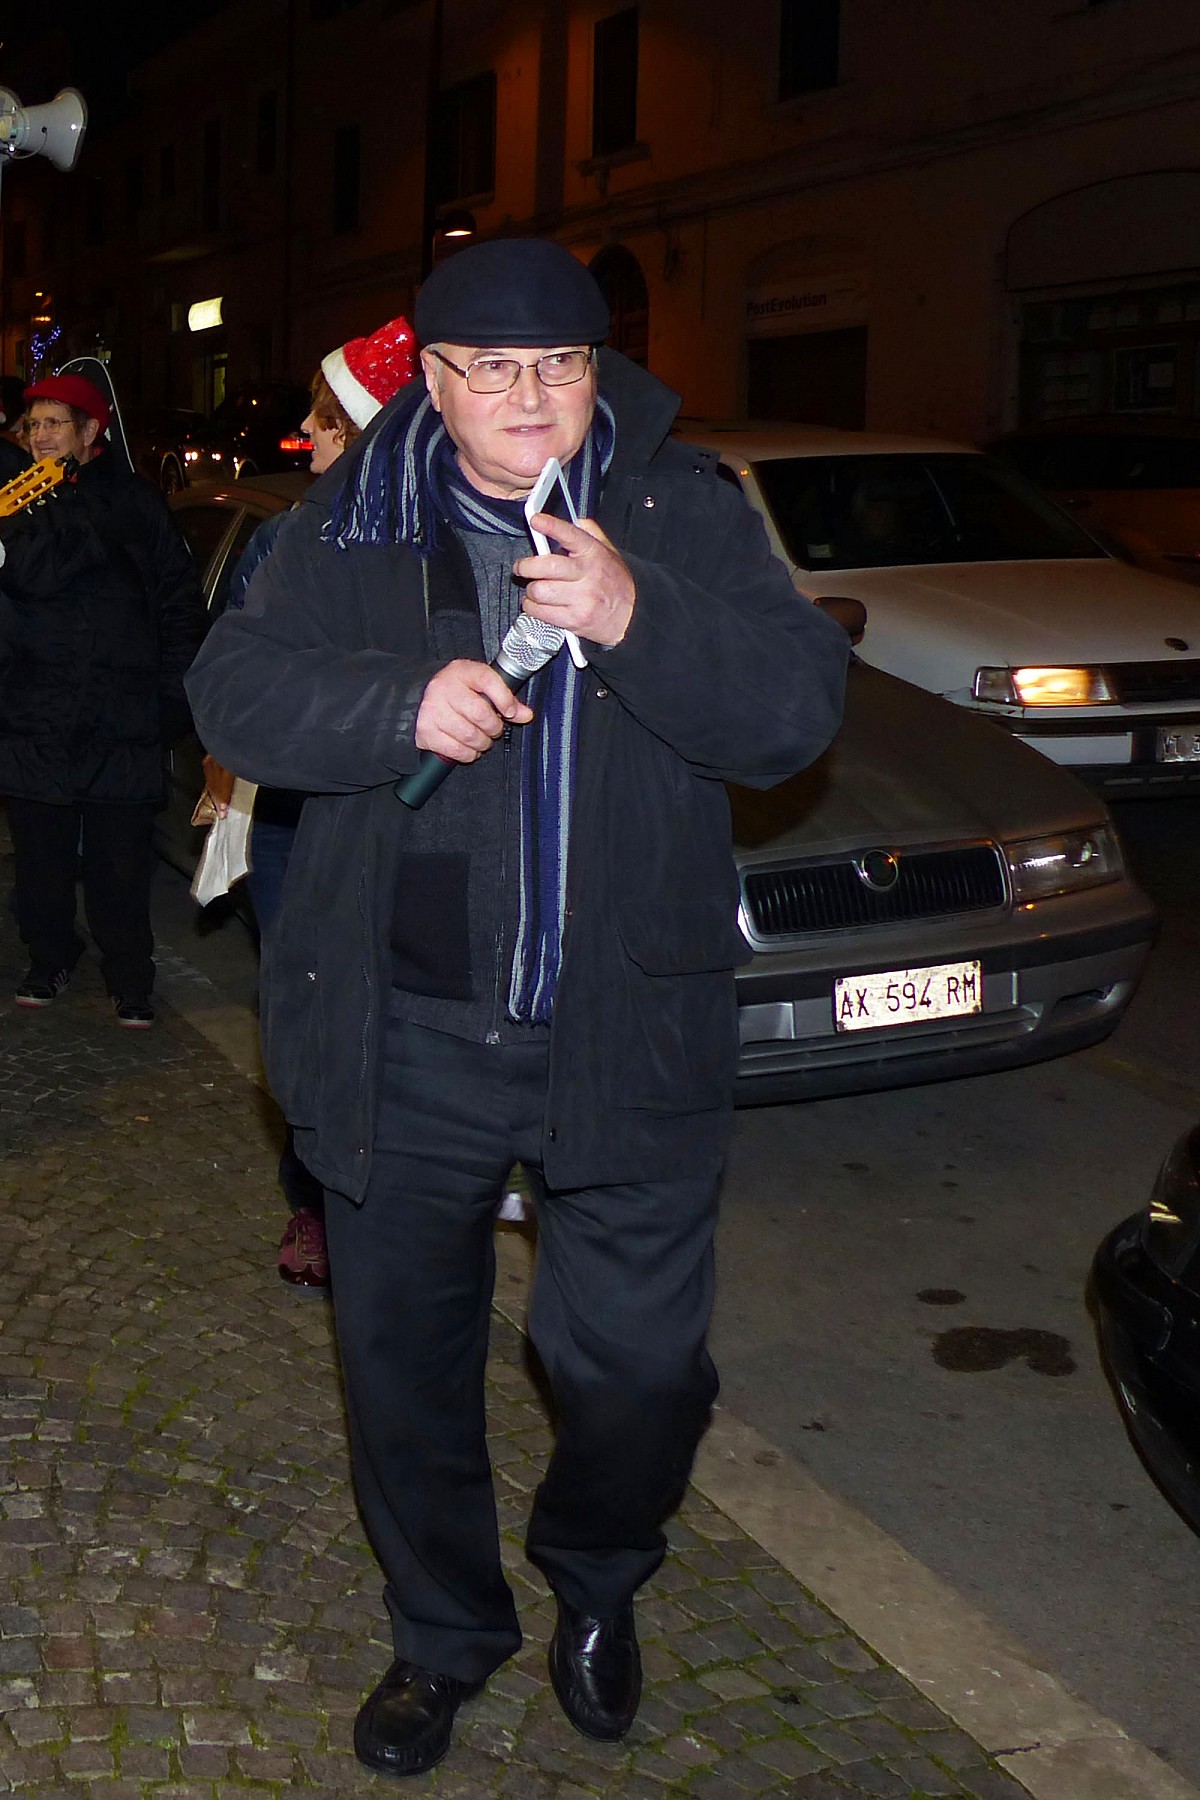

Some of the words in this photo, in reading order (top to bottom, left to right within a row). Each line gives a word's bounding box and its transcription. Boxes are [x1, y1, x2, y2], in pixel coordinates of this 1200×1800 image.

[746, 292, 827, 317] PostEvolution
[841, 988, 870, 1019] AX
[886, 978, 932, 1012] 594
[947, 973, 976, 1004] RM
